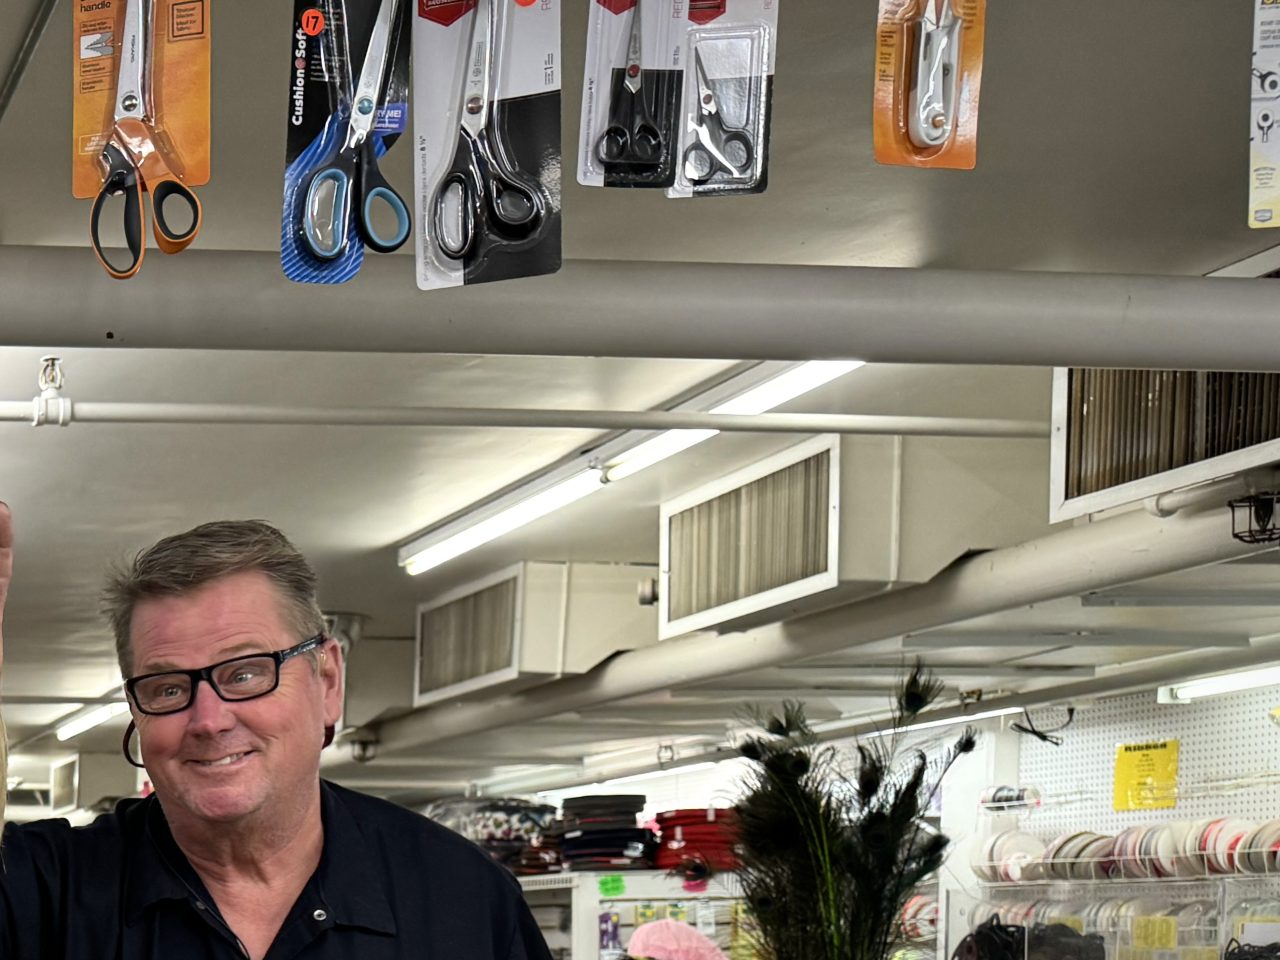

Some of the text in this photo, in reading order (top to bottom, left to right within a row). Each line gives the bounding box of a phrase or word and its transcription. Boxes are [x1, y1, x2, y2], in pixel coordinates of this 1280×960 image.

[306, 16, 319, 31] 17
[292, 27, 307, 126] Cushion Soft
